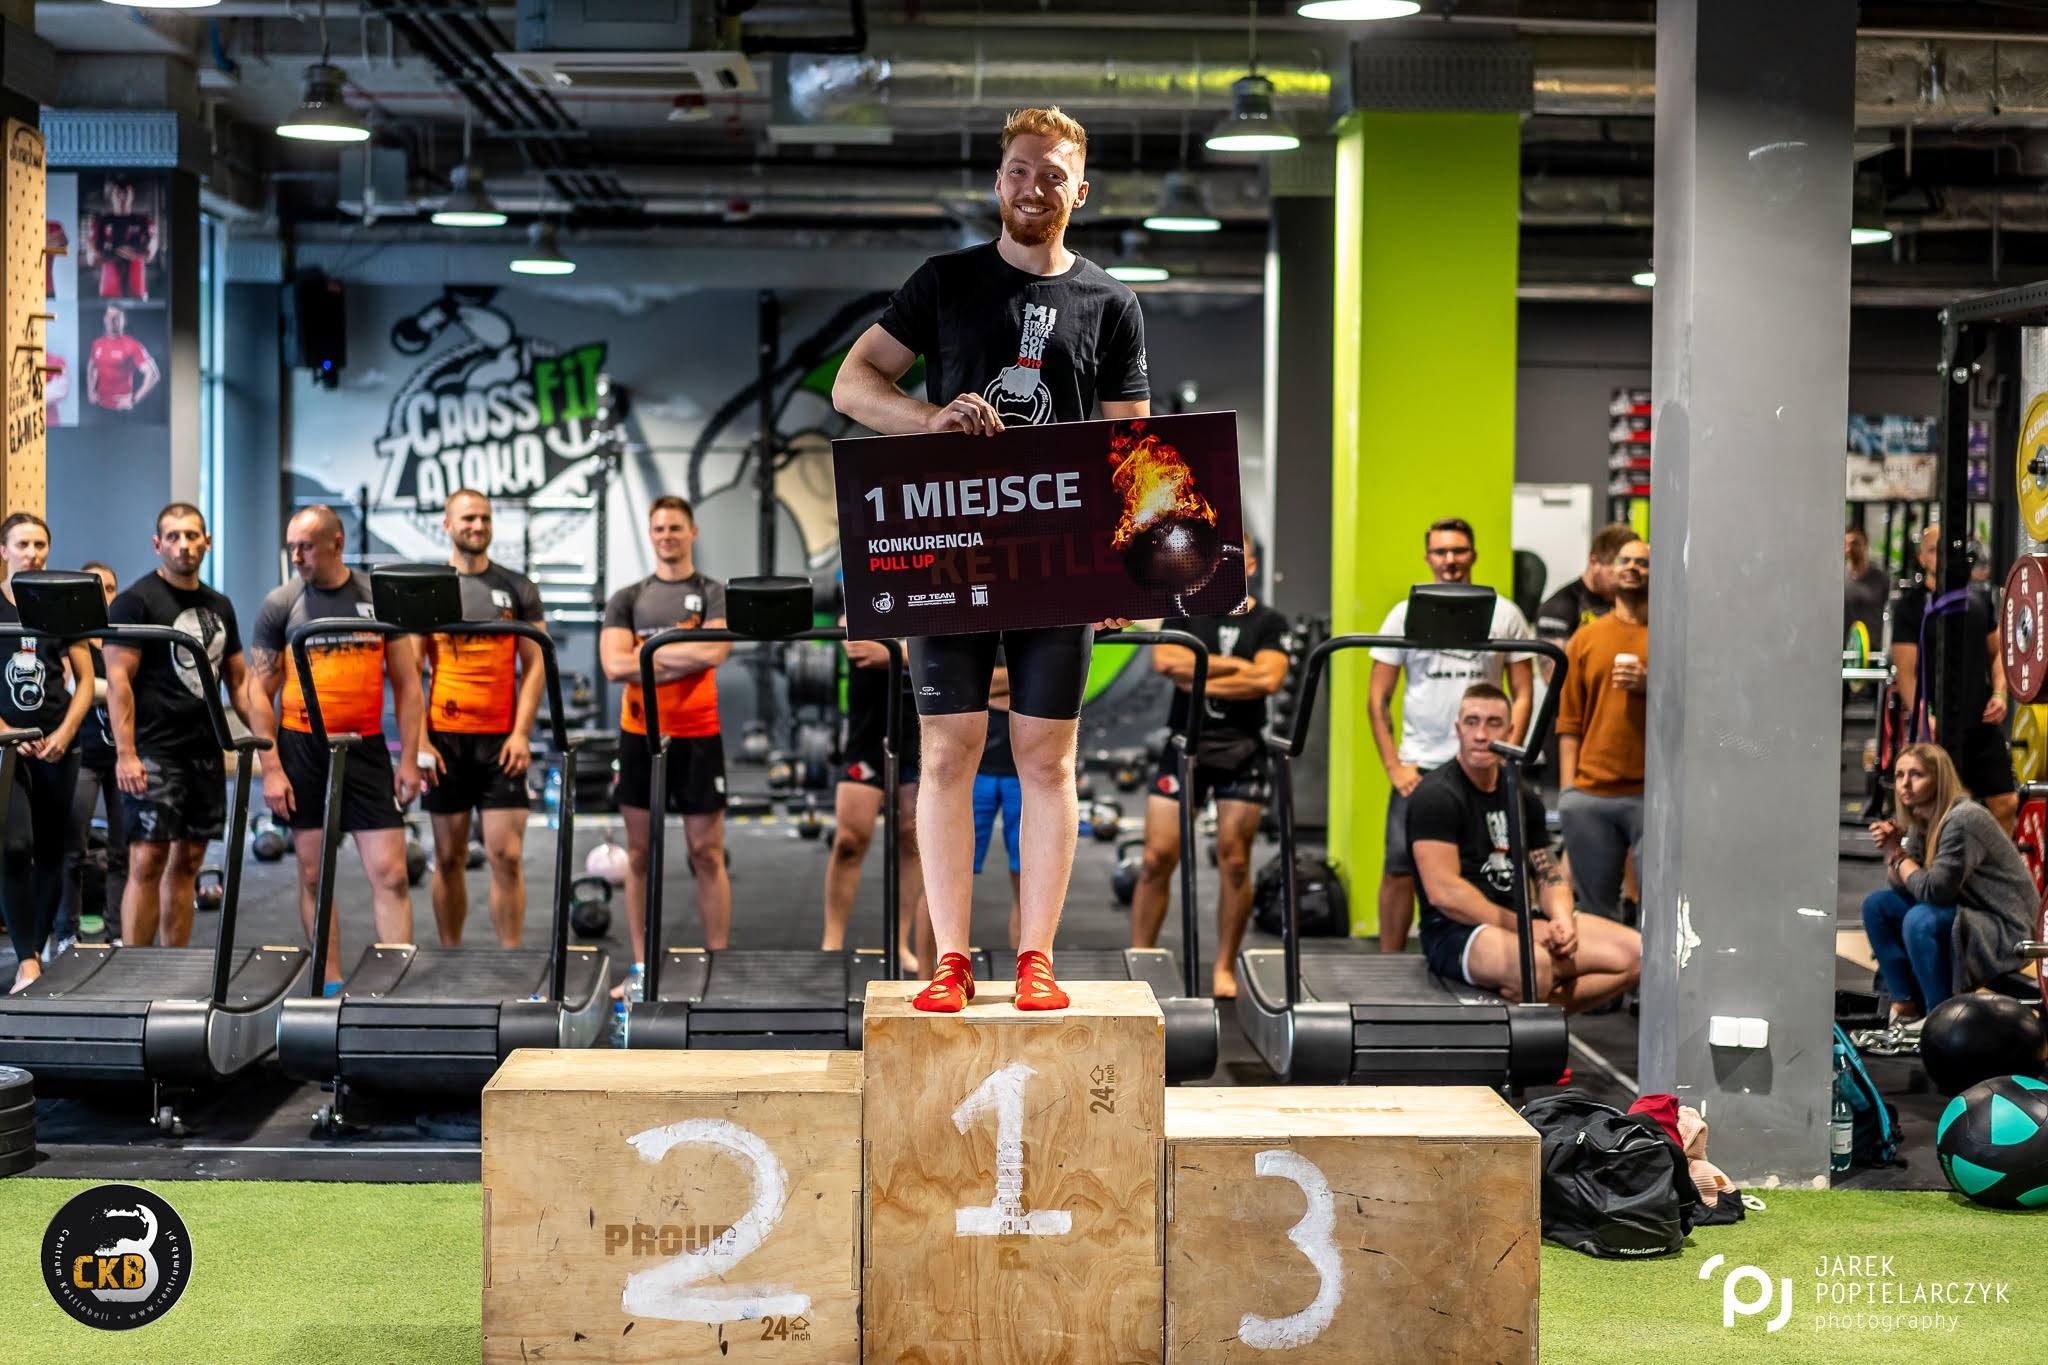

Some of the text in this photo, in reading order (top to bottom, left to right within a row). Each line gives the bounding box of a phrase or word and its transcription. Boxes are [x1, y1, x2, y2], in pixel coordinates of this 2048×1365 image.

[1016, 357, 1042, 369] 2019
[865, 472, 1081, 521] 1 MIEJSCE
[869, 532, 983, 553] KONKURENCJA
[870, 554, 935, 571] PULL UP
[2021, 567, 2028, 595] 25
[929, 592, 955, 600] TEAM
[2036, 591, 2044, 662] ELEIKO
[2021, 664, 2029, 691] 25
[1090, 1064, 1115, 1114] 24 inch
[951, 1062, 1072, 1237] 1
[622, 1118, 812, 1324] 2
[1238, 1150, 1345, 1351] 3
[761, 1316, 811, 1341] 24 inch
